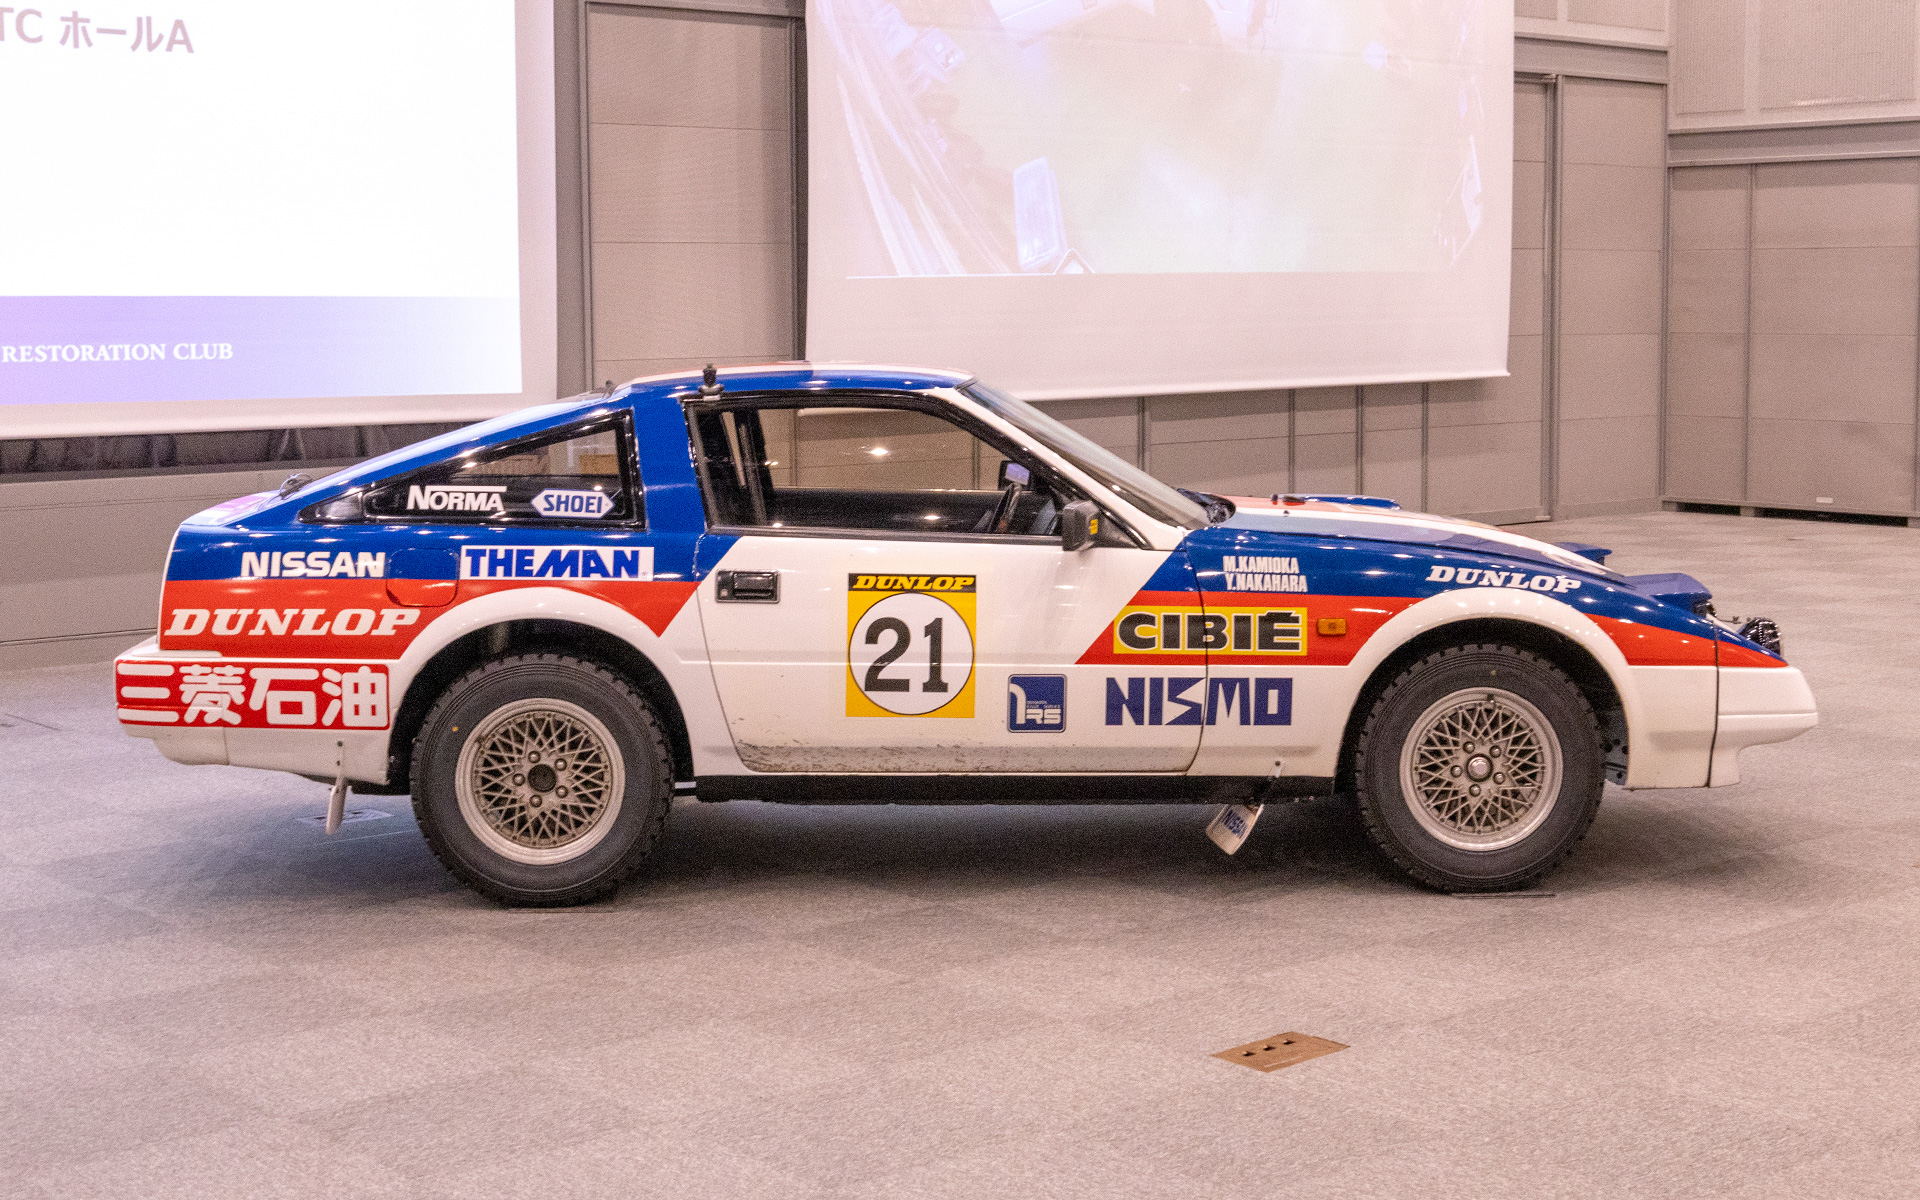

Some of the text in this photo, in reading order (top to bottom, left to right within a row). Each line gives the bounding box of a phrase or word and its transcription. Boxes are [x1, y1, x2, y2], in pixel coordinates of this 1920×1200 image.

[1, 343, 234, 362] RESTORATION CLUB
[407, 485, 507, 511] NORMA
[543, 494, 603, 514] SHOEI
[240, 551, 386, 577] NISSAN
[853, 575, 974, 591] DUNLOP
[1225, 574, 1308, 592] Y.NAKAHARA
[1425, 565, 1581, 594] DUNLOP
[164, 608, 420, 636] DUNLOP
[864, 617, 949, 692] 21
[117, 663, 388, 727] 三菱石油
[1105, 677, 1293, 725] NISMO
